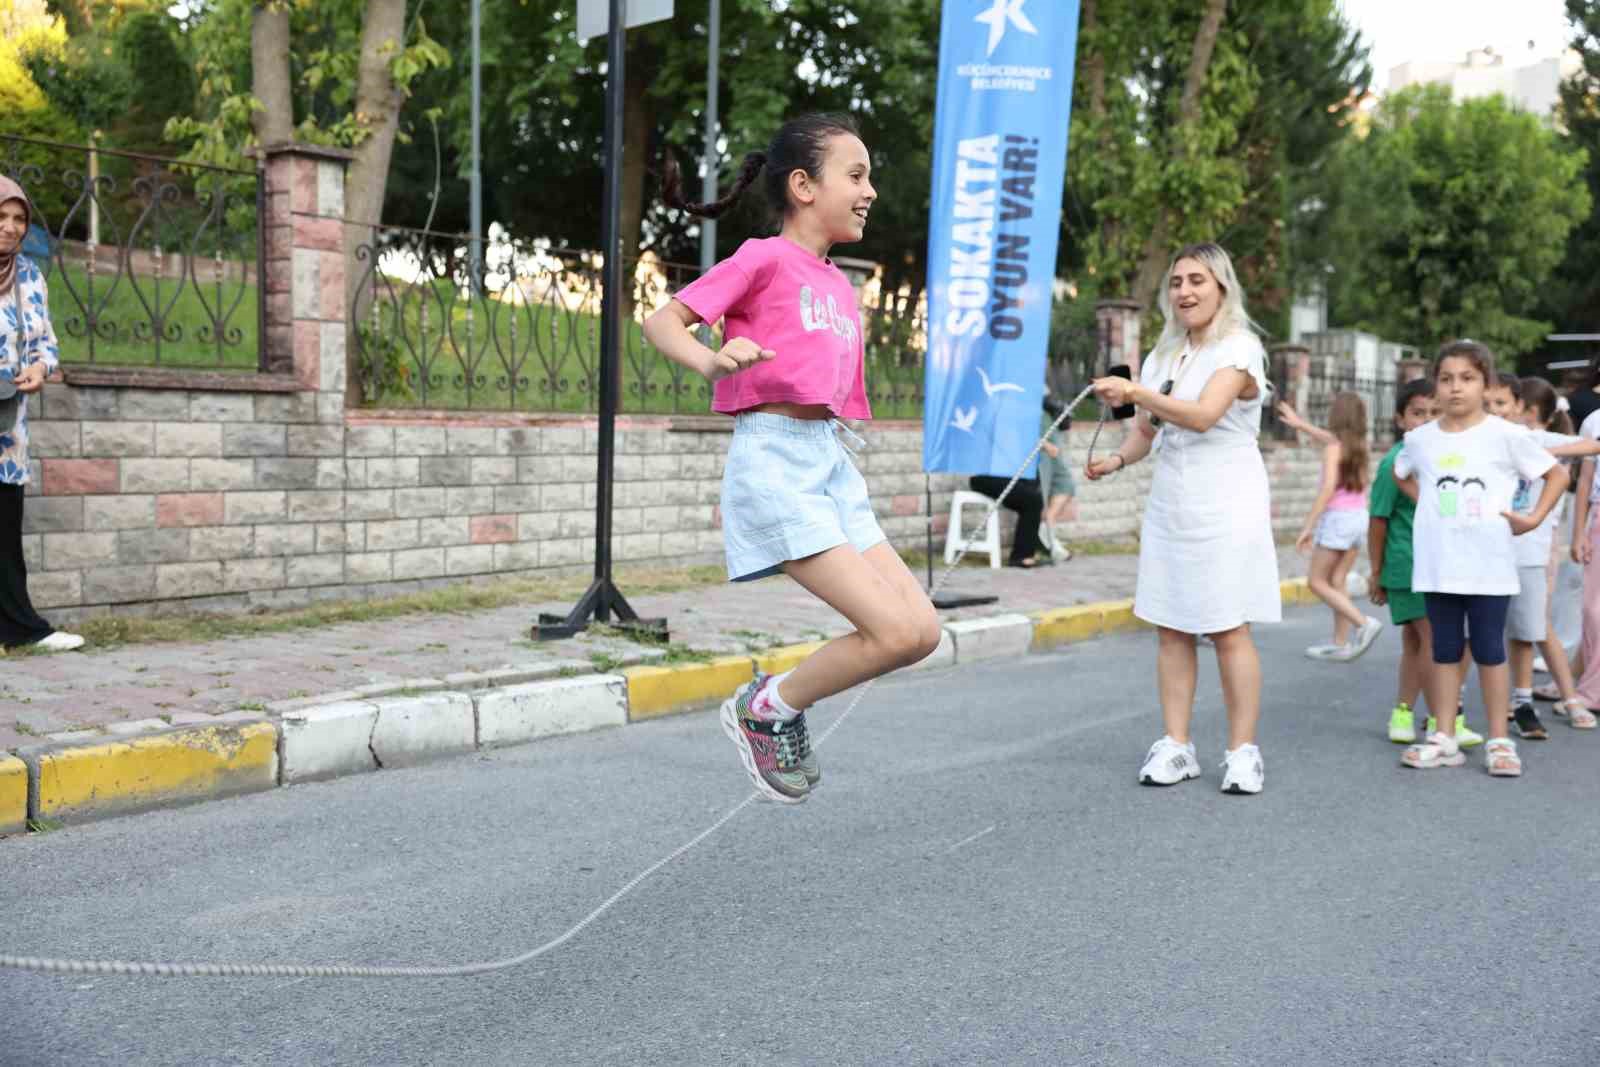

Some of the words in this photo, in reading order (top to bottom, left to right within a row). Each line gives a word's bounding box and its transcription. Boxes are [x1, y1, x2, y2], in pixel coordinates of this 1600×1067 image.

[1000, 134, 1040, 222] VAR!
[946, 133, 999, 338] SOKAKTA
[989, 234, 1031, 341] OYUN
